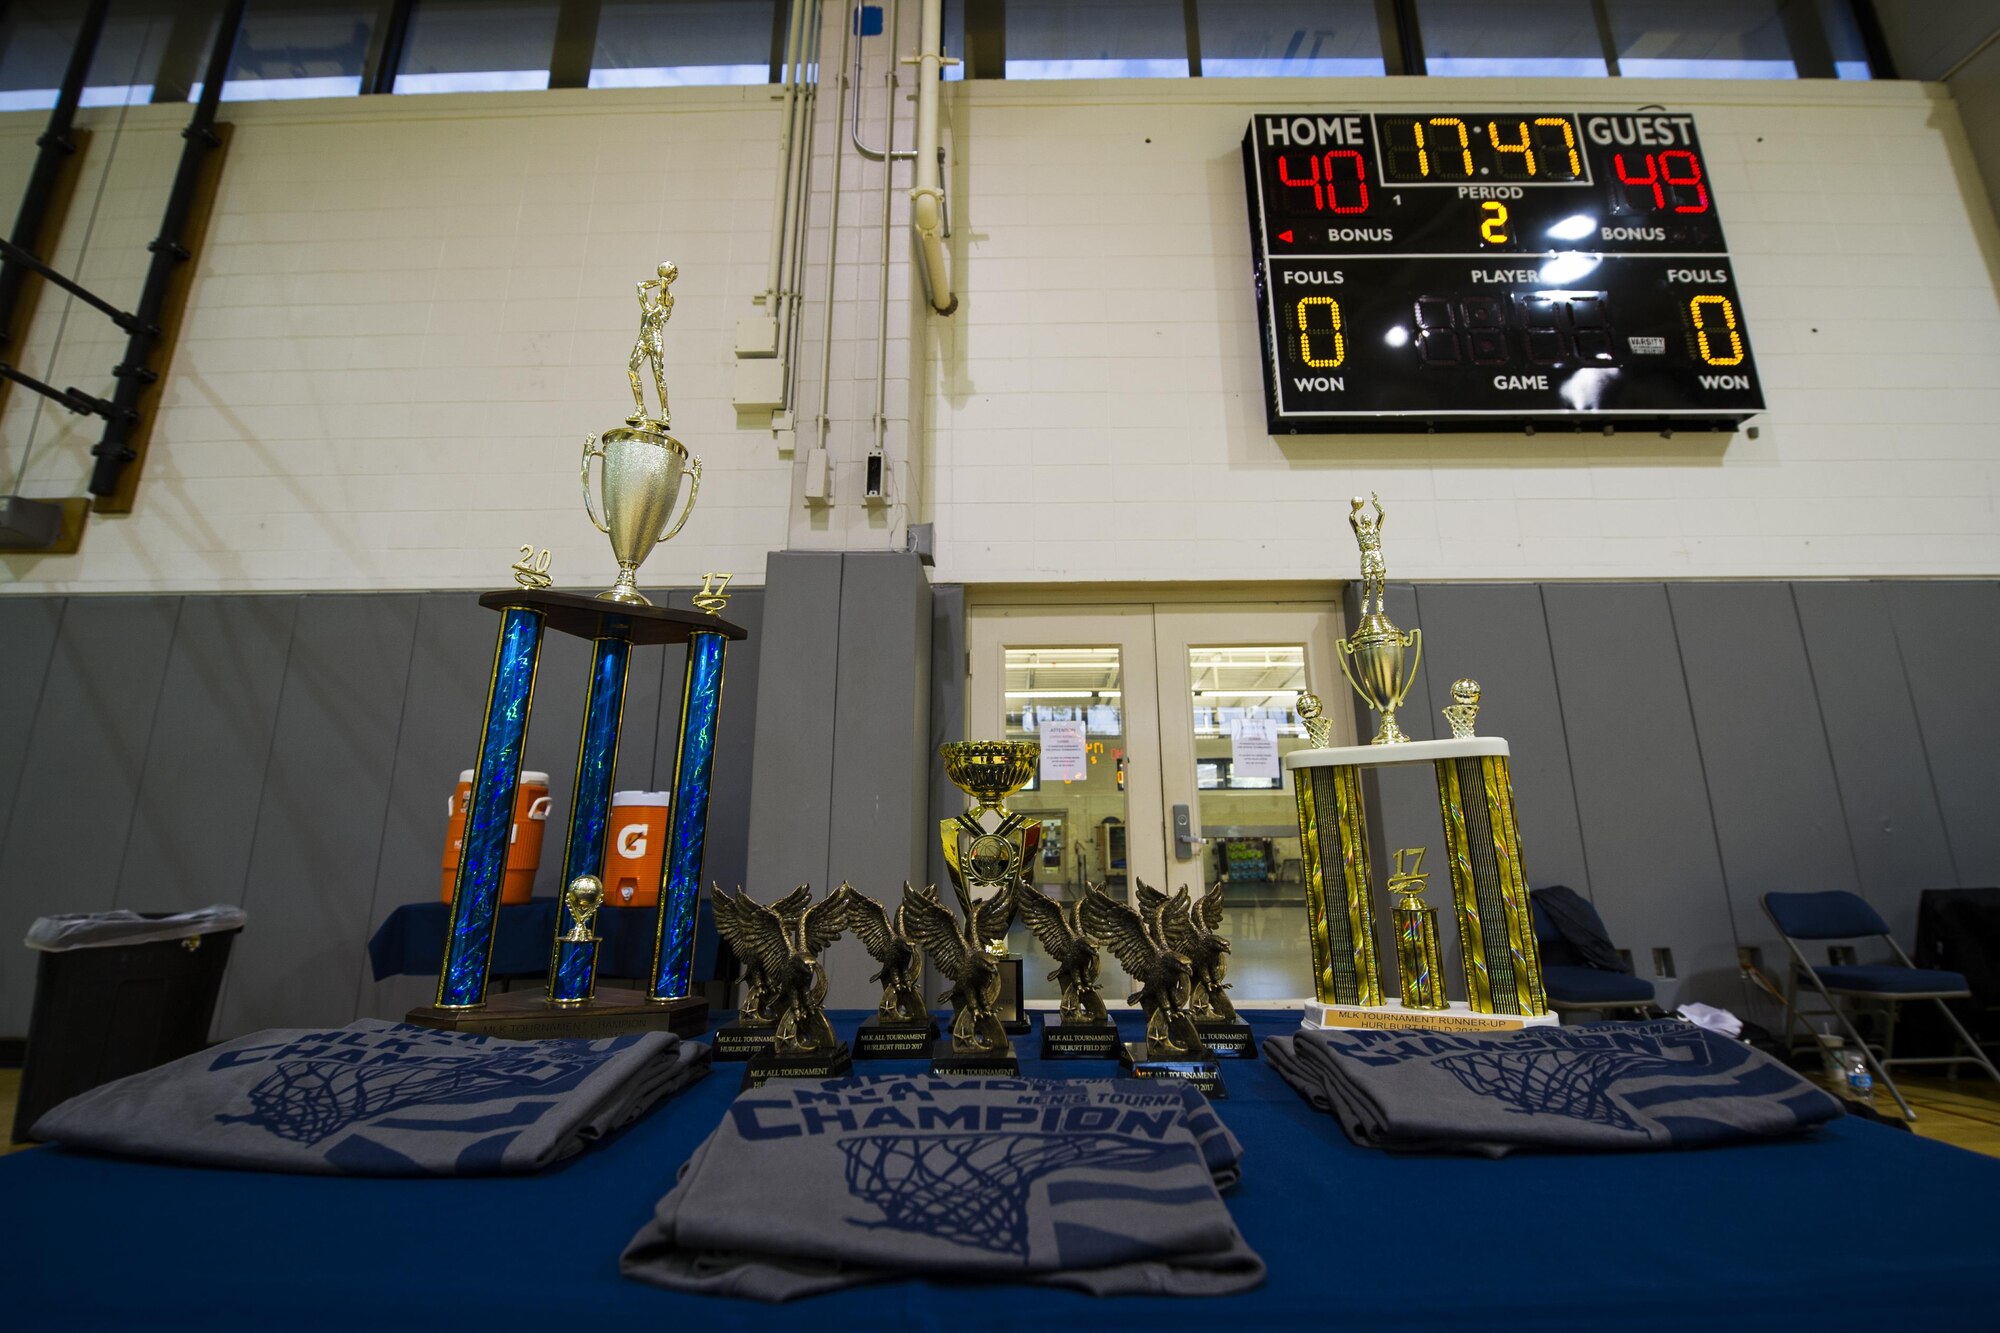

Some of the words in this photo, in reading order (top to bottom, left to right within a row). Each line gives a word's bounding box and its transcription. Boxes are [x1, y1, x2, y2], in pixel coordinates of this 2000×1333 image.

[1265, 117, 1364, 146] HOME
[1587, 116, 1692, 146] GUEST
[1278, 150, 1370, 214] 40
[1614, 150, 1709, 214] 49
[1458, 186, 1524, 199] PERIOD
[1481, 201, 1508, 243] 2
[1328, 228, 1394, 242] BONUS
[1600, 227, 1666, 241] BONUS
[1283, 270, 1345, 285] FOULS
[1471, 269, 1539, 283] PLAYER
[1666, 269, 1728, 283] FOULS
[1297, 296, 1345, 368] 0
[1690, 295, 1744, 366] 0
[1293, 377, 1345, 392] WON
[1493, 375, 1549, 390] GAME
[1699, 375, 1750, 390] WON
[513, 544, 552, 574] 20
[701, 572, 733, 597] 17
[617, 823, 648, 859] G
[1392, 847, 1426, 878] 17
[1338, 1011, 1359, 1019] MLK
[1362, 1013, 1436, 1024] TOURNAMENT
[1439, 1017, 1507, 1028] RUNNER-UP
[750, 1069, 766, 1078] MLK
[766, 1069, 779, 1077] ALL
[780, 1067, 829, 1077] TOURNAMENT
[966, 1068, 1015, 1077] TOURNAMENT
[1168, 1071, 1217, 1080] TOURNAMENT
[1199, 1083, 1213, 1091] 2017
[1096, 1093, 1182, 1107] TOURNA
[731, 1100, 1190, 1140] CHAMPION
